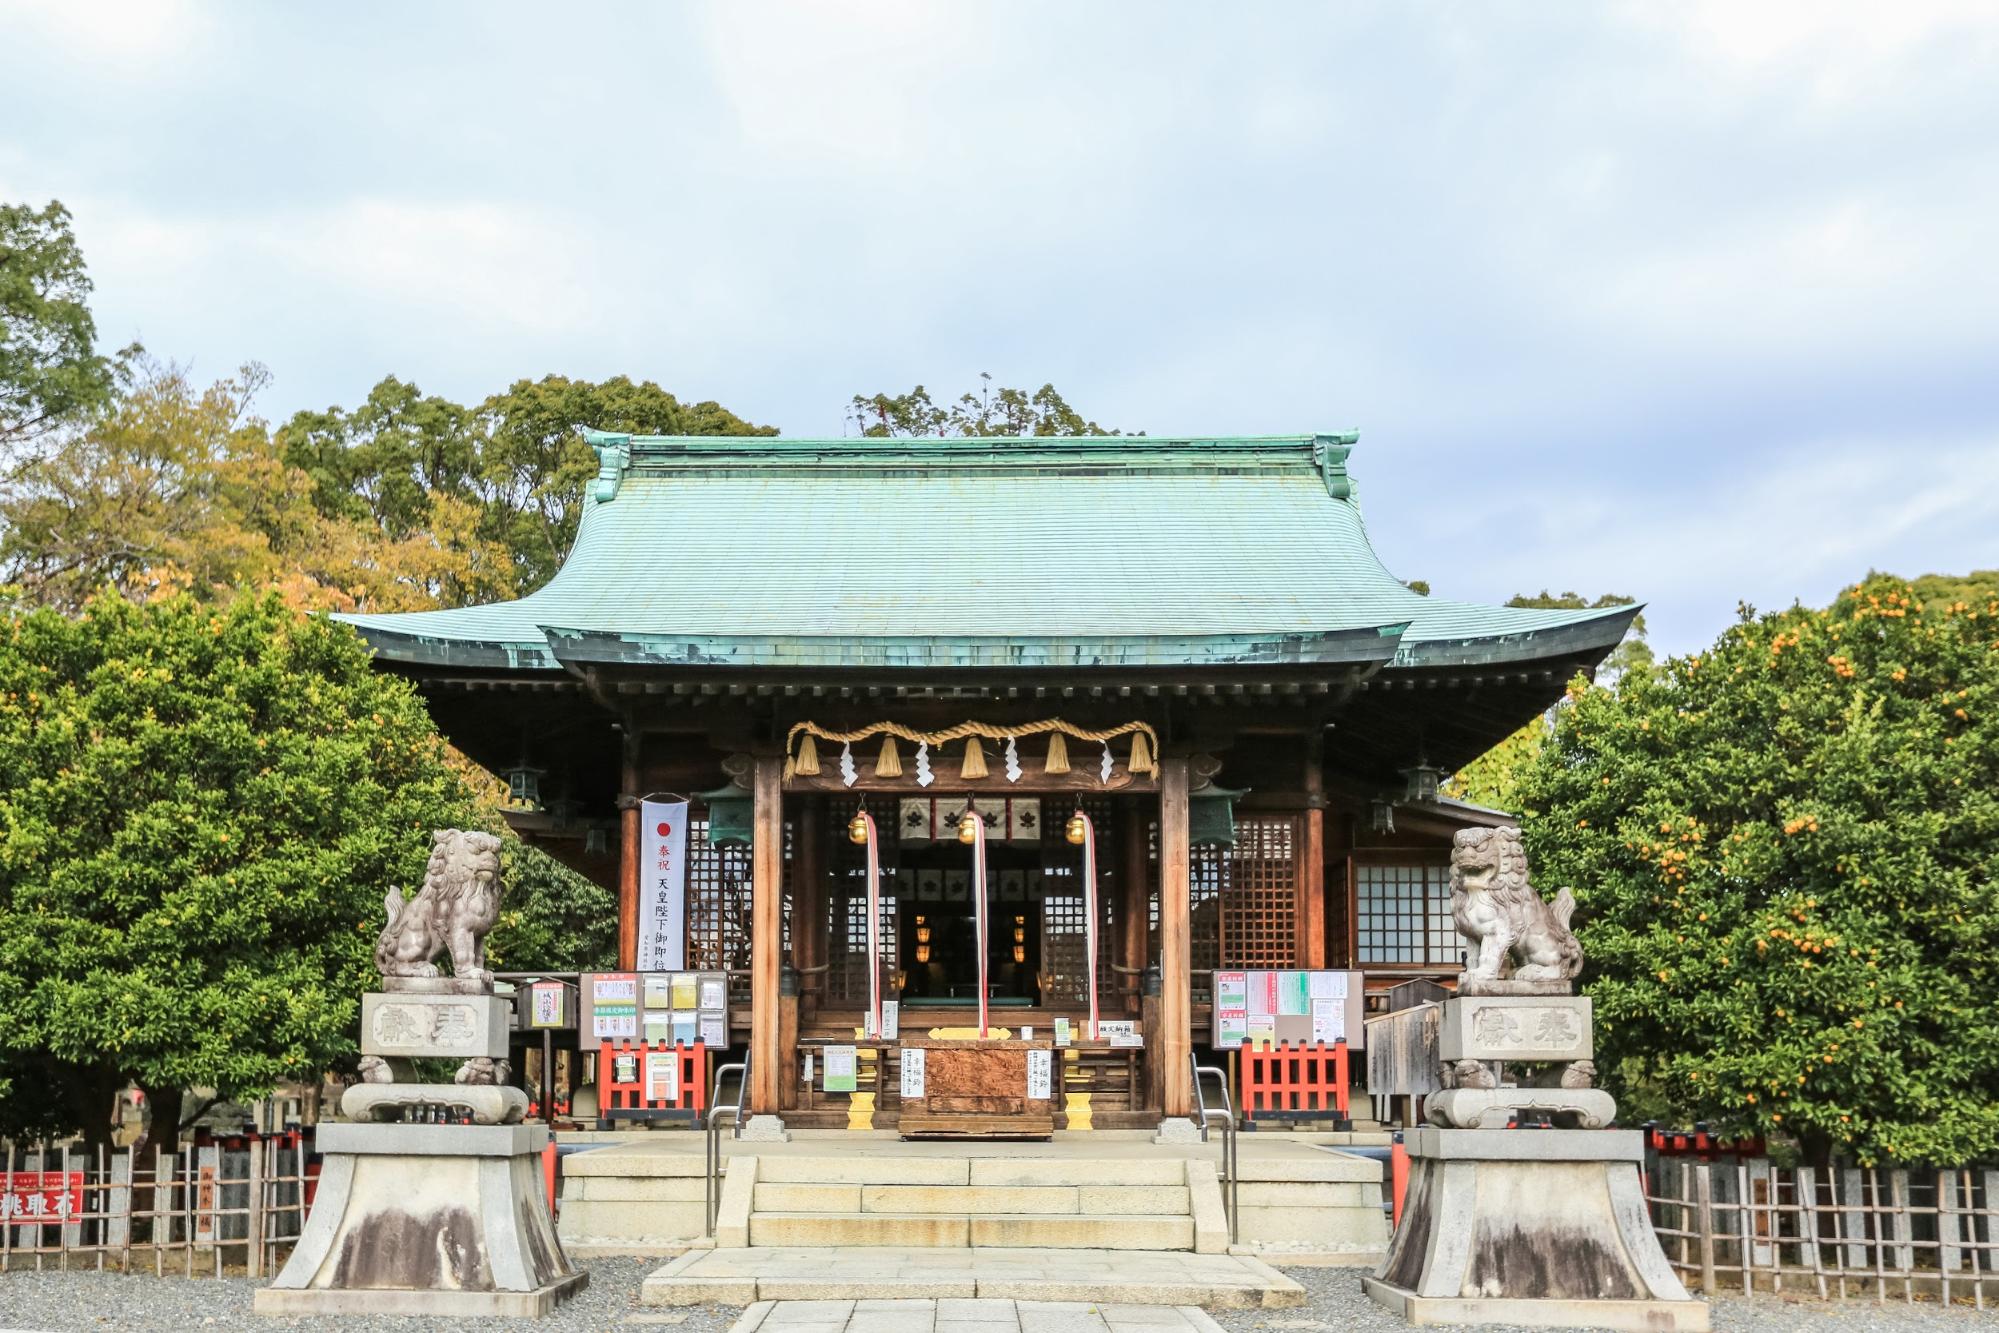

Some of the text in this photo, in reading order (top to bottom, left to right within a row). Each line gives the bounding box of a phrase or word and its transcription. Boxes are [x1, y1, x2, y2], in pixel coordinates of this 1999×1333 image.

[658, 844, 670, 871] 奉祝
[653, 879, 669, 971] 天皇陛下御即位
